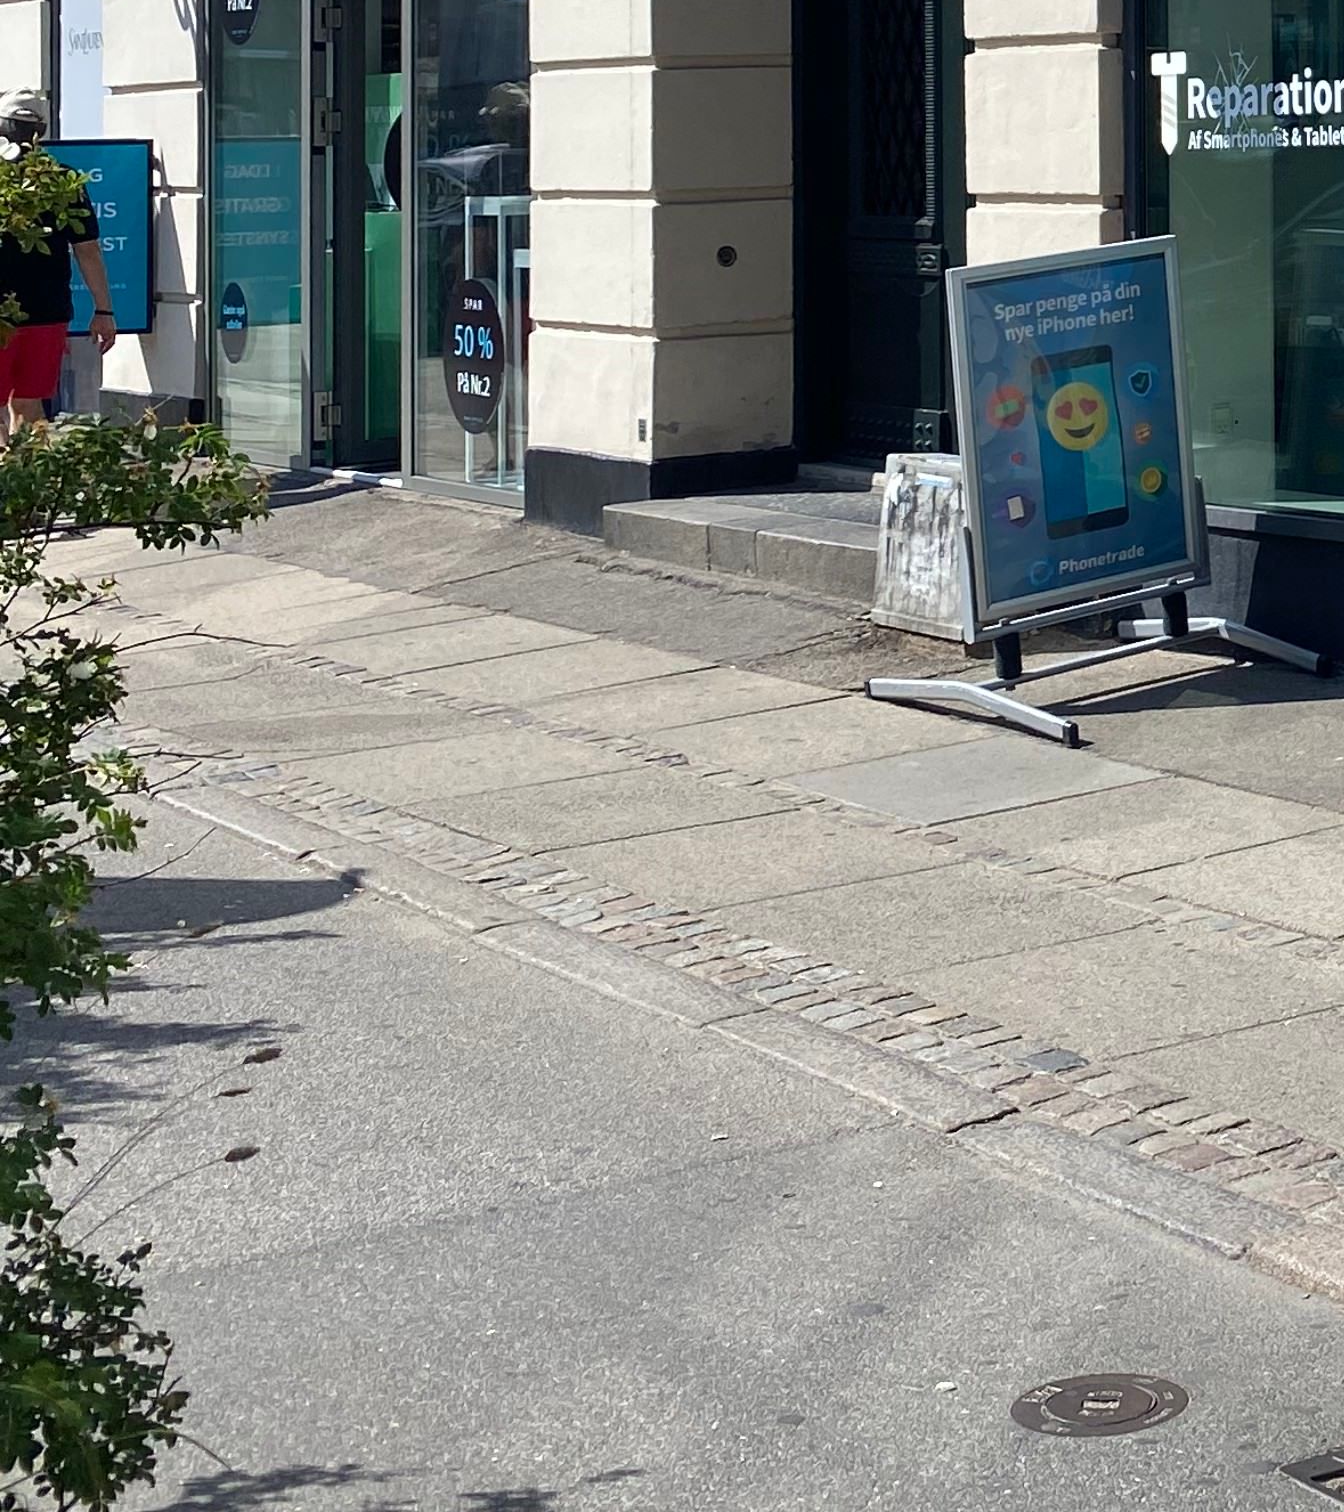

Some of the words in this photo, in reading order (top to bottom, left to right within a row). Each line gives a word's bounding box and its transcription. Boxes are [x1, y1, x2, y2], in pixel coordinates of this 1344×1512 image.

[1188, 129, 1203, 150] Af
[1204, 127, 1290, 152] Smartphones
[1291, 127, 1302, 148] &
[463, 297, 483, 311] SPAR
[994, 301, 1033, 322] Spar
[1036, 292, 1087, 316] penge
[1091, 283, 1112, 308] på
[1115, 281, 1141, 301] din
[1004, 324, 1035, 344] nye
[1037, 313, 1097, 336] iPhone
[1100, 304, 1135, 325] her!
[454, 324, 474, 358] 50
[477, 326, 494, 360] %
[457, 372, 469, 394] På
[1058, 544, 1145, 575] Phonetrade
